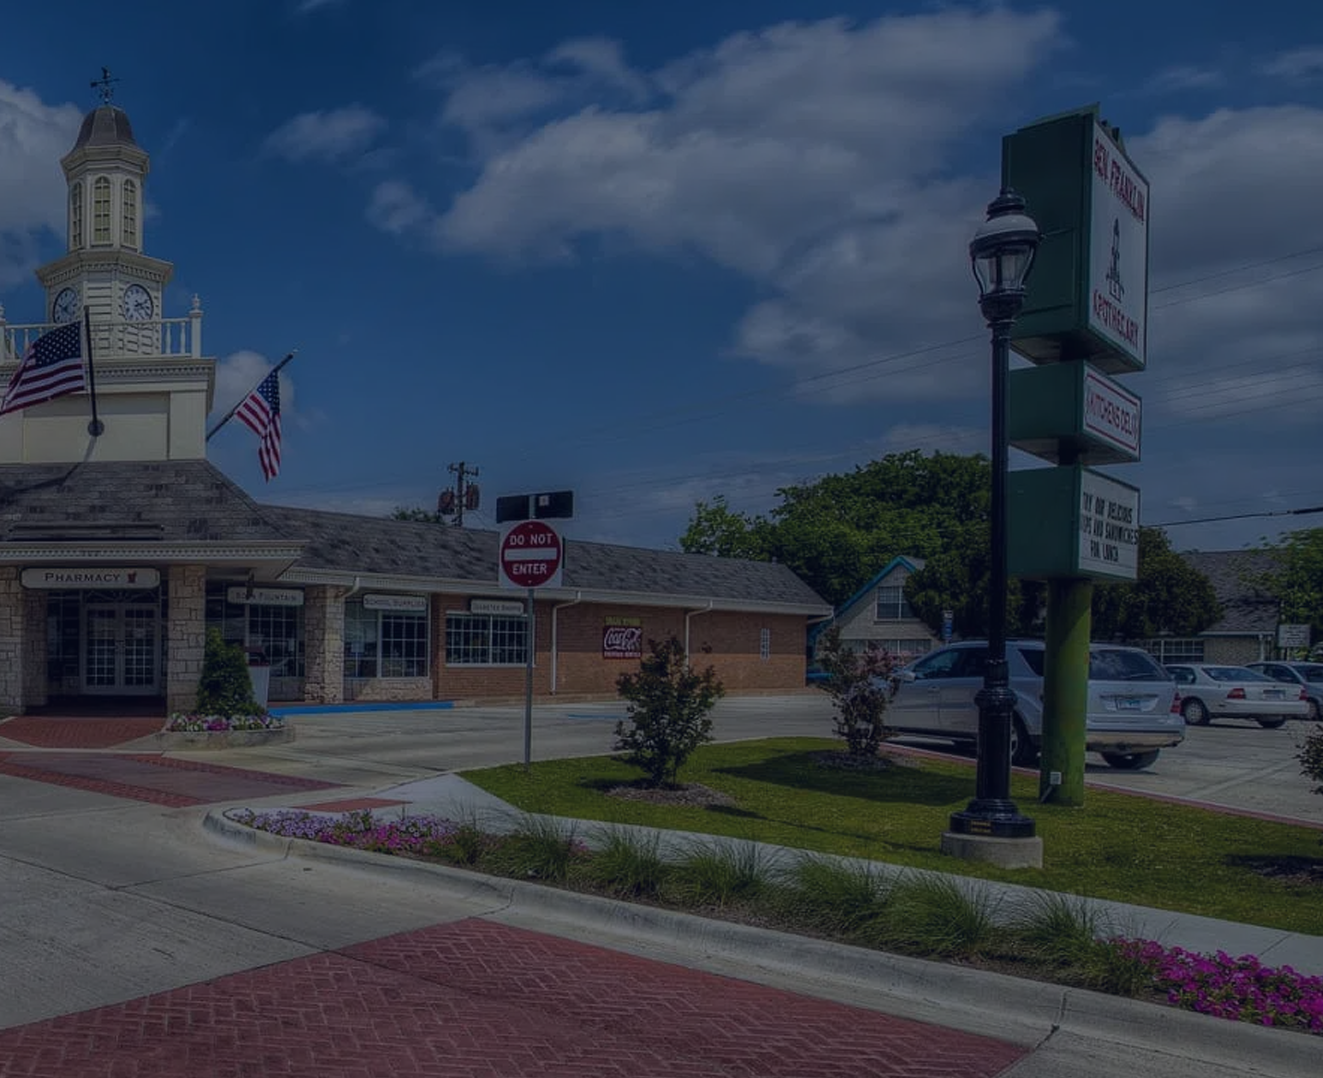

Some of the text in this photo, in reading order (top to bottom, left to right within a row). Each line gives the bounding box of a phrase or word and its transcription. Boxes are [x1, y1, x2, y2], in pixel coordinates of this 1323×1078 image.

[1094, 138, 1145, 224] BEN FRANKLIN
[509, 533, 553, 546] DO NOT
[512, 563, 547, 575] ENTER
[44, 572, 120, 582] PHARMACY
